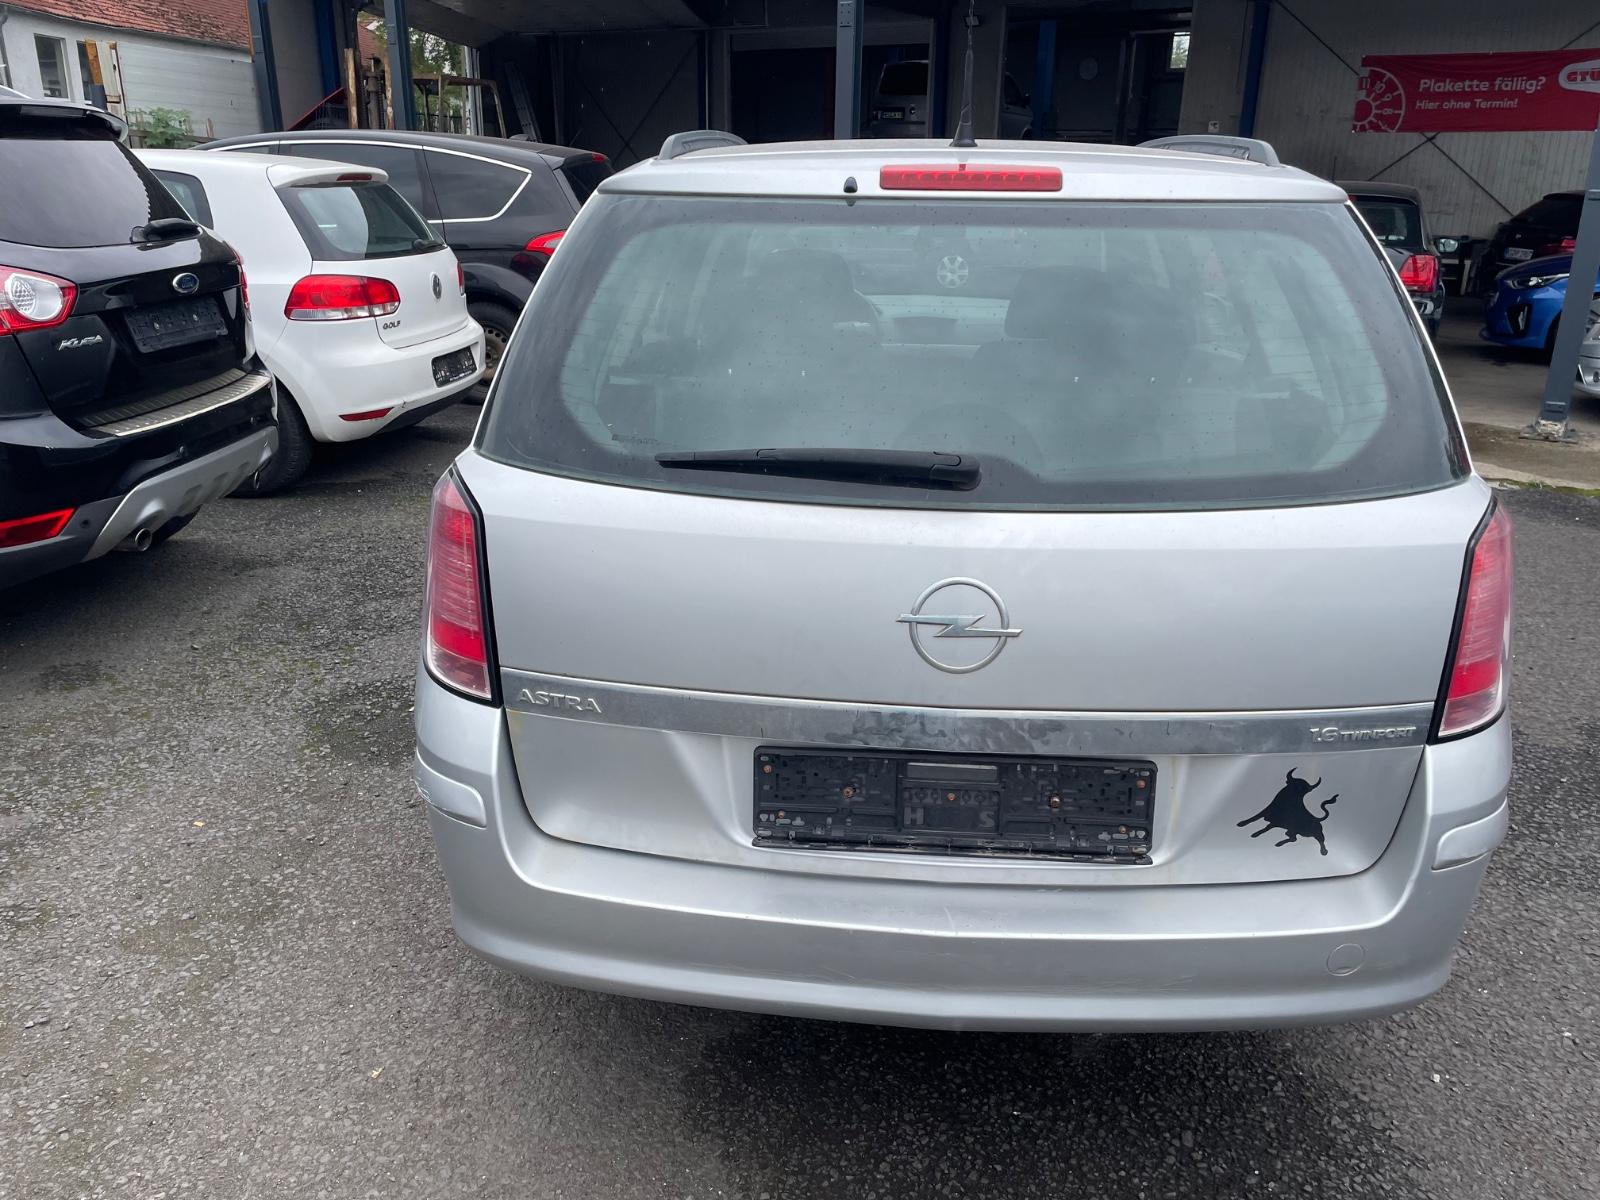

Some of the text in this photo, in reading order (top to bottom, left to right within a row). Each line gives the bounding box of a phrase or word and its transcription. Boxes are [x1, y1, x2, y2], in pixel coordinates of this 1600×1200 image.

[1418, 76, 1546, 94] Plakette fällig?
[1415, 98, 1519, 110] Hier ohne Termin!
[383, 320, 401, 330] GOLF
[520, 688, 602, 713] ASTRA
